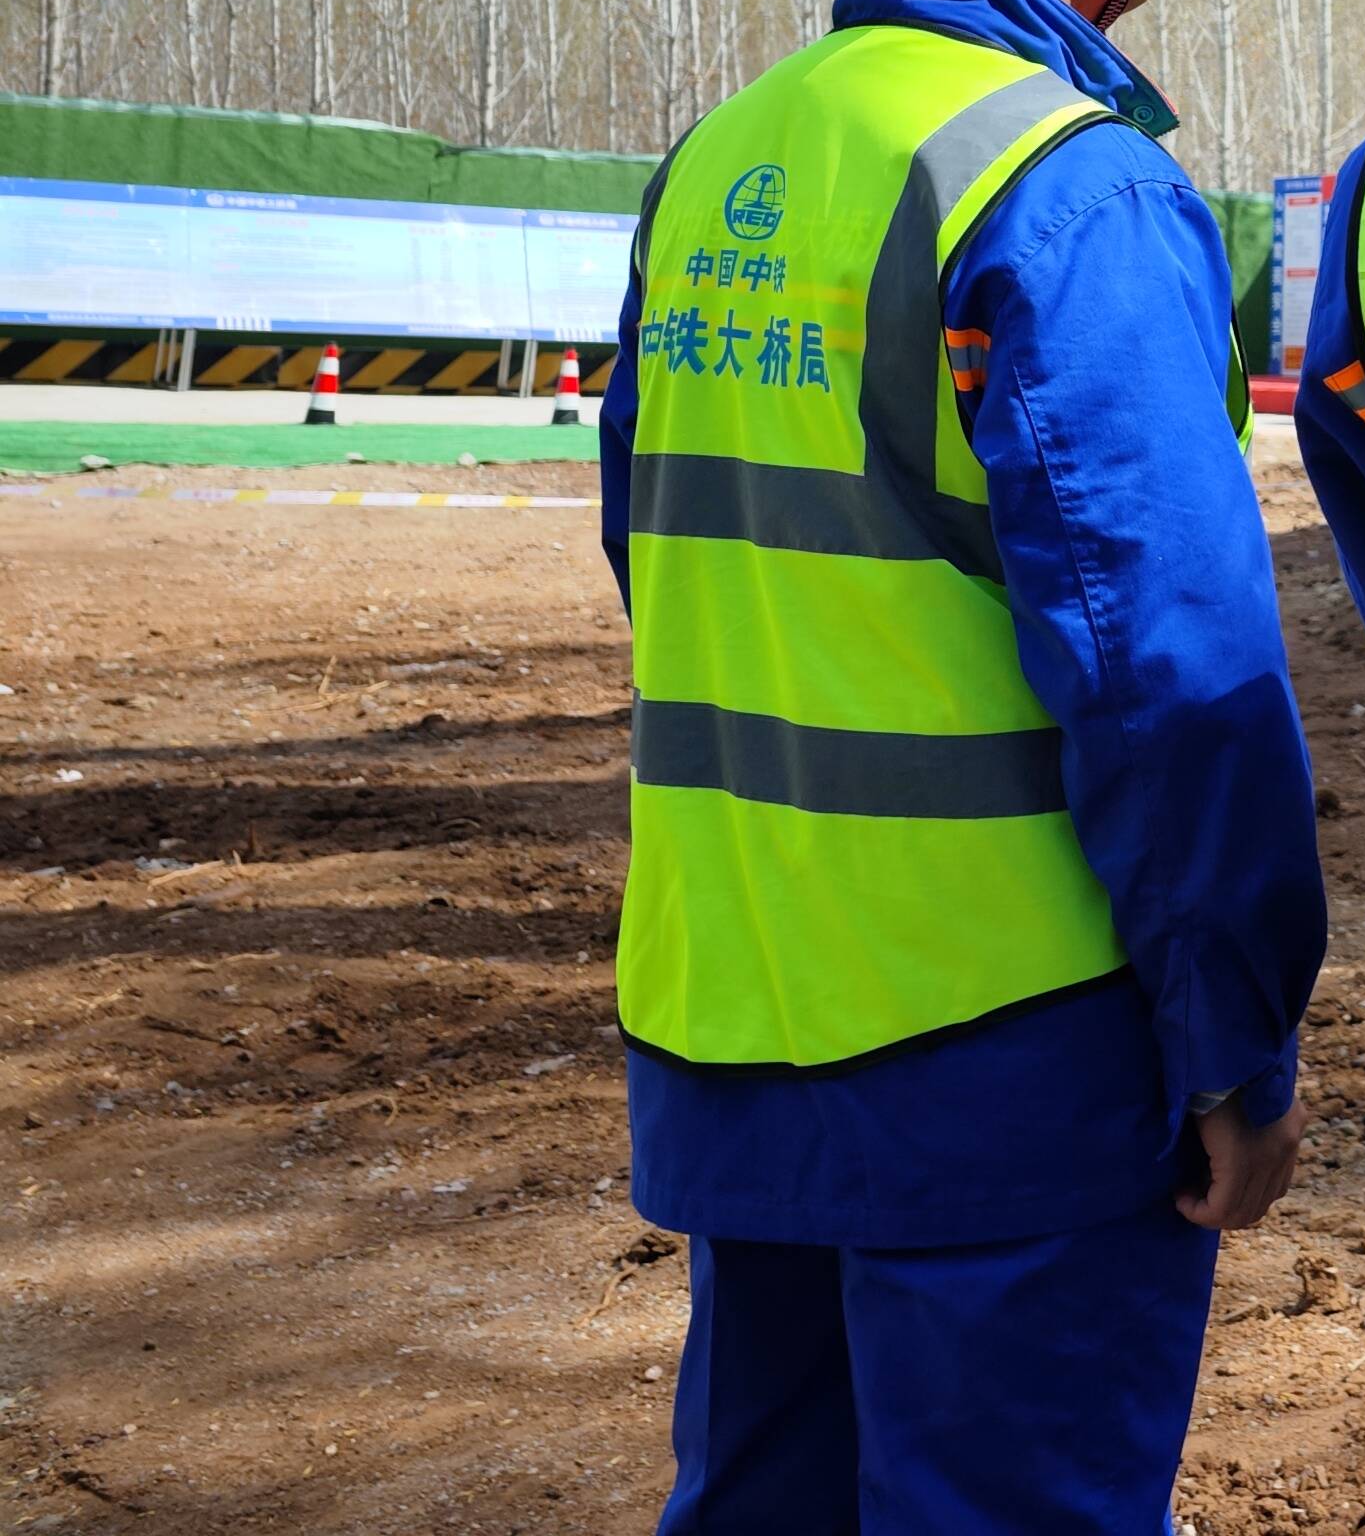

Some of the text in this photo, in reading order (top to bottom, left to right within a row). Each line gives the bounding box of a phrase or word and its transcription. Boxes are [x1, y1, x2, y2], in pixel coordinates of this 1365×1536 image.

[685, 247, 787, 294] 中国中铁
[641, 307, 831, 393] 中铁大桥局
